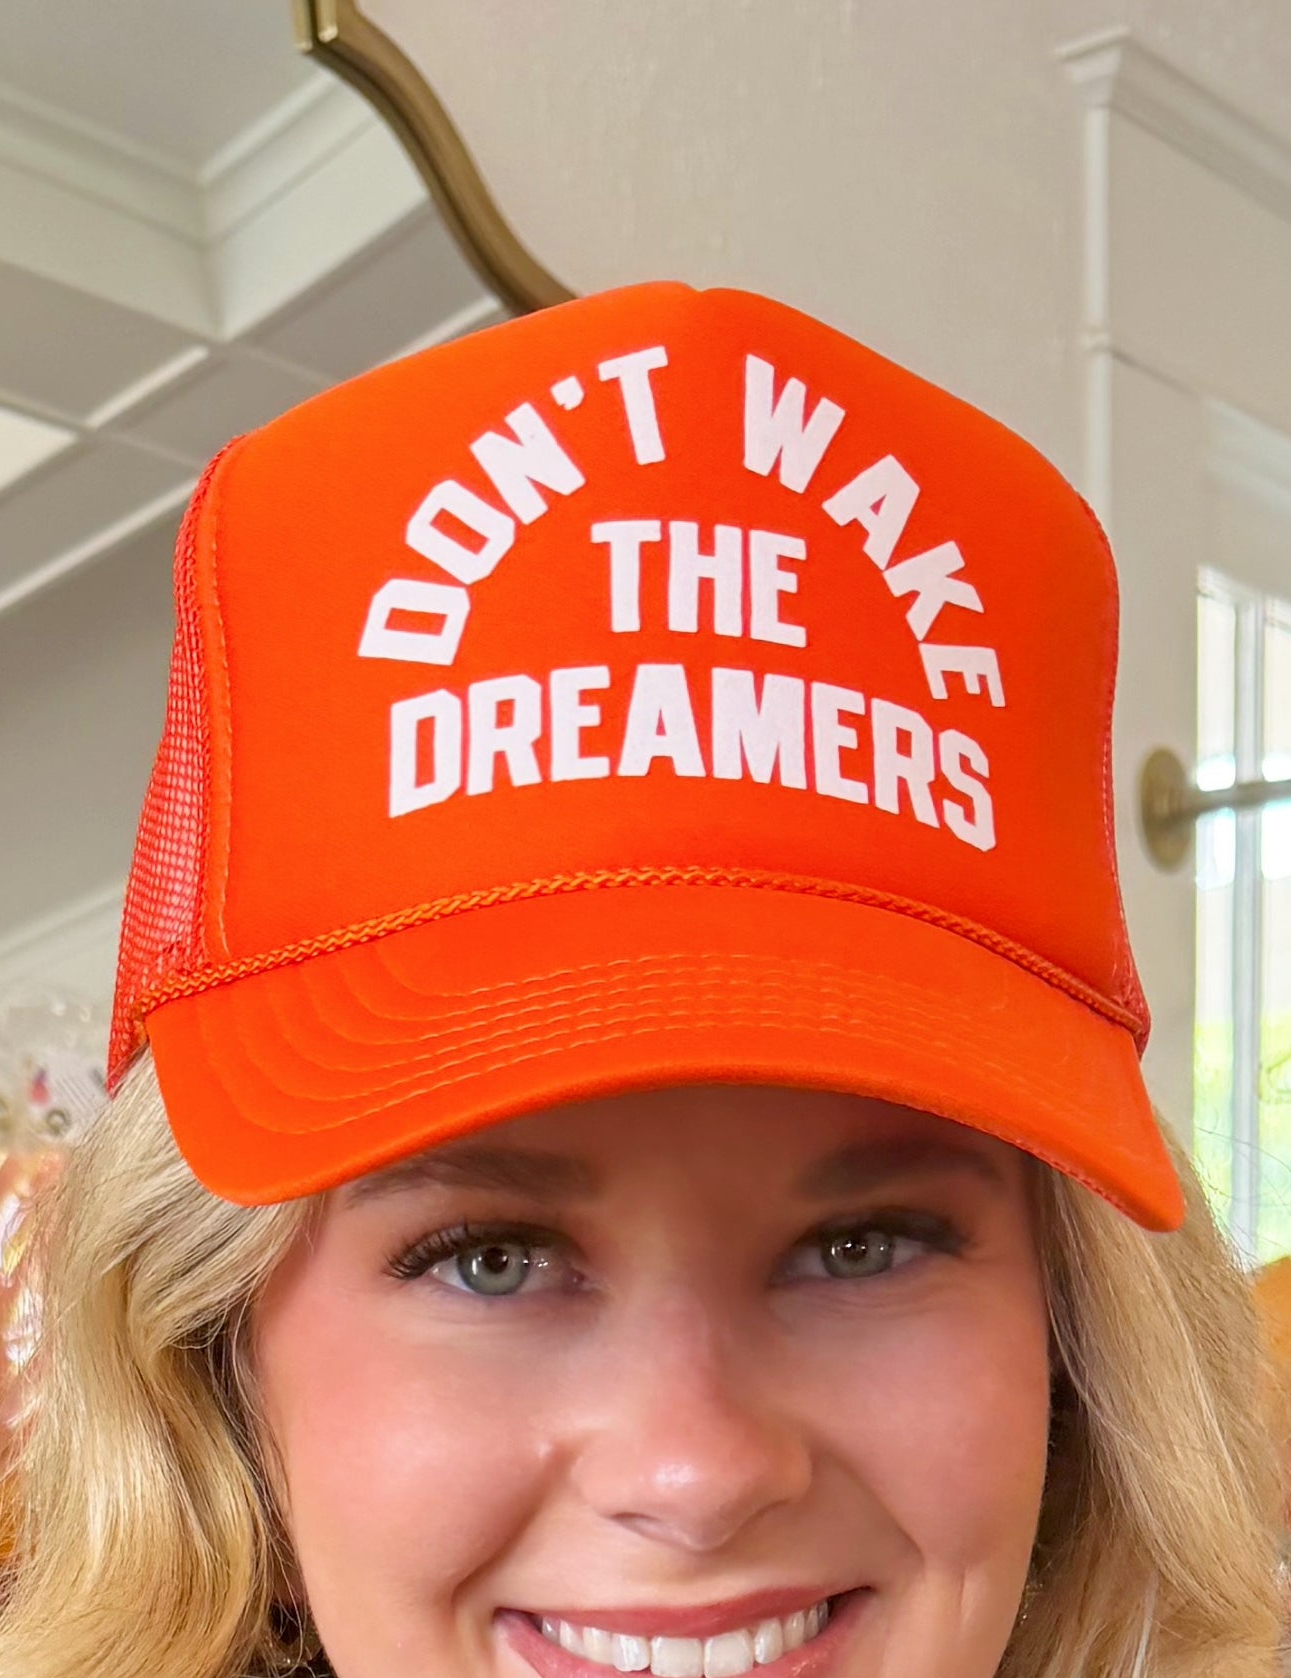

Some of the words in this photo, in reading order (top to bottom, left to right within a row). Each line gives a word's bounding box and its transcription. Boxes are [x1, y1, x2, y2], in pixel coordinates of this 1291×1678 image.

[357, 346, 669, 666] DON'T
[743, 353, 1007, 708] WAKE
[590, 519, 807, 648] THE
[388, 663, 996, 852] DREAMERS
